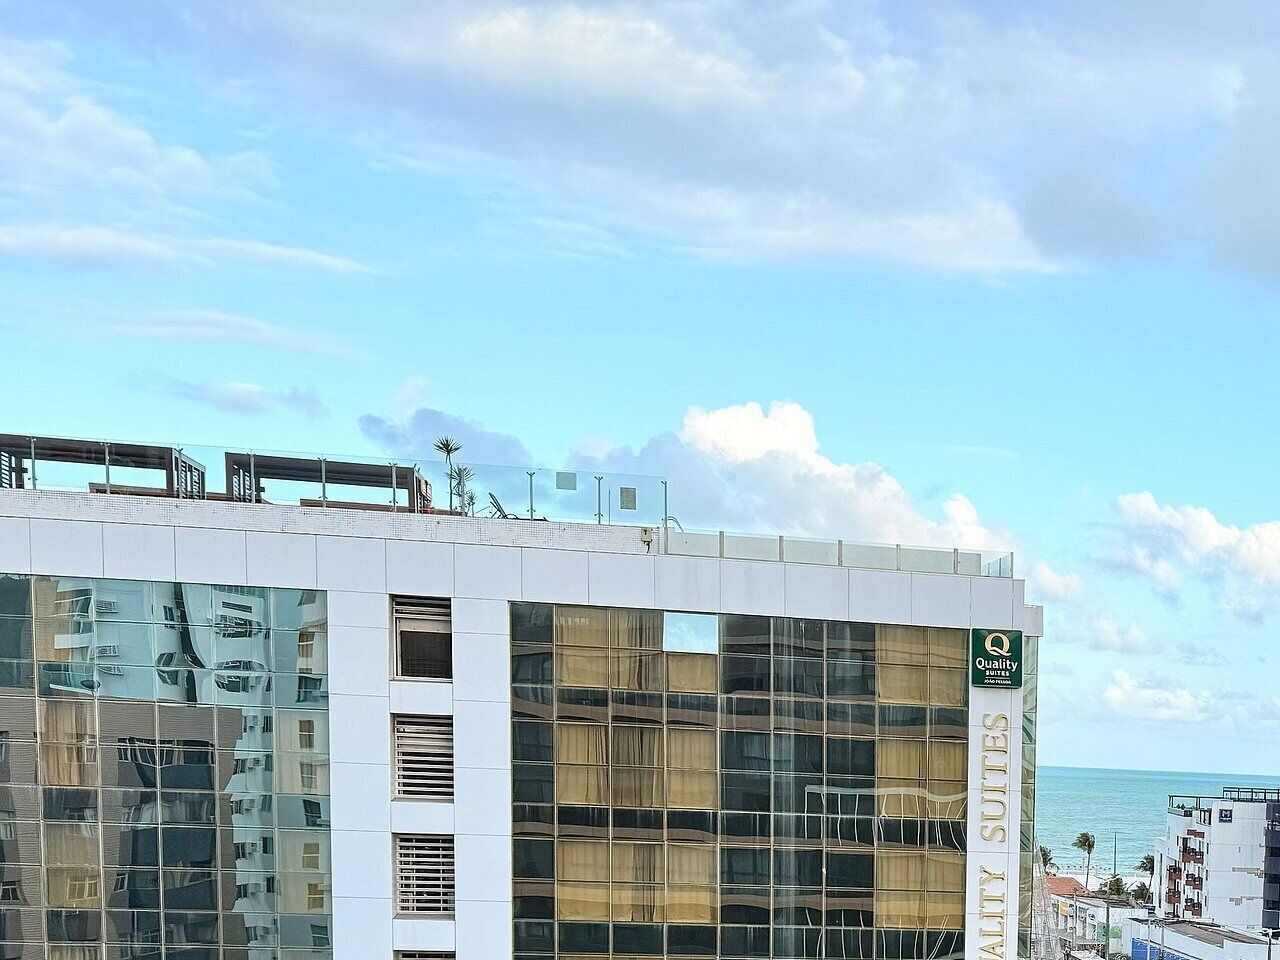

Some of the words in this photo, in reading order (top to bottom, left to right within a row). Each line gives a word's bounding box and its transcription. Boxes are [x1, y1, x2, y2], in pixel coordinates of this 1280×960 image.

[984, 632, 1012, 656] Q
[976, 657, 1018, 672] Quality
[980, 713, 1008, 843] SUITES
